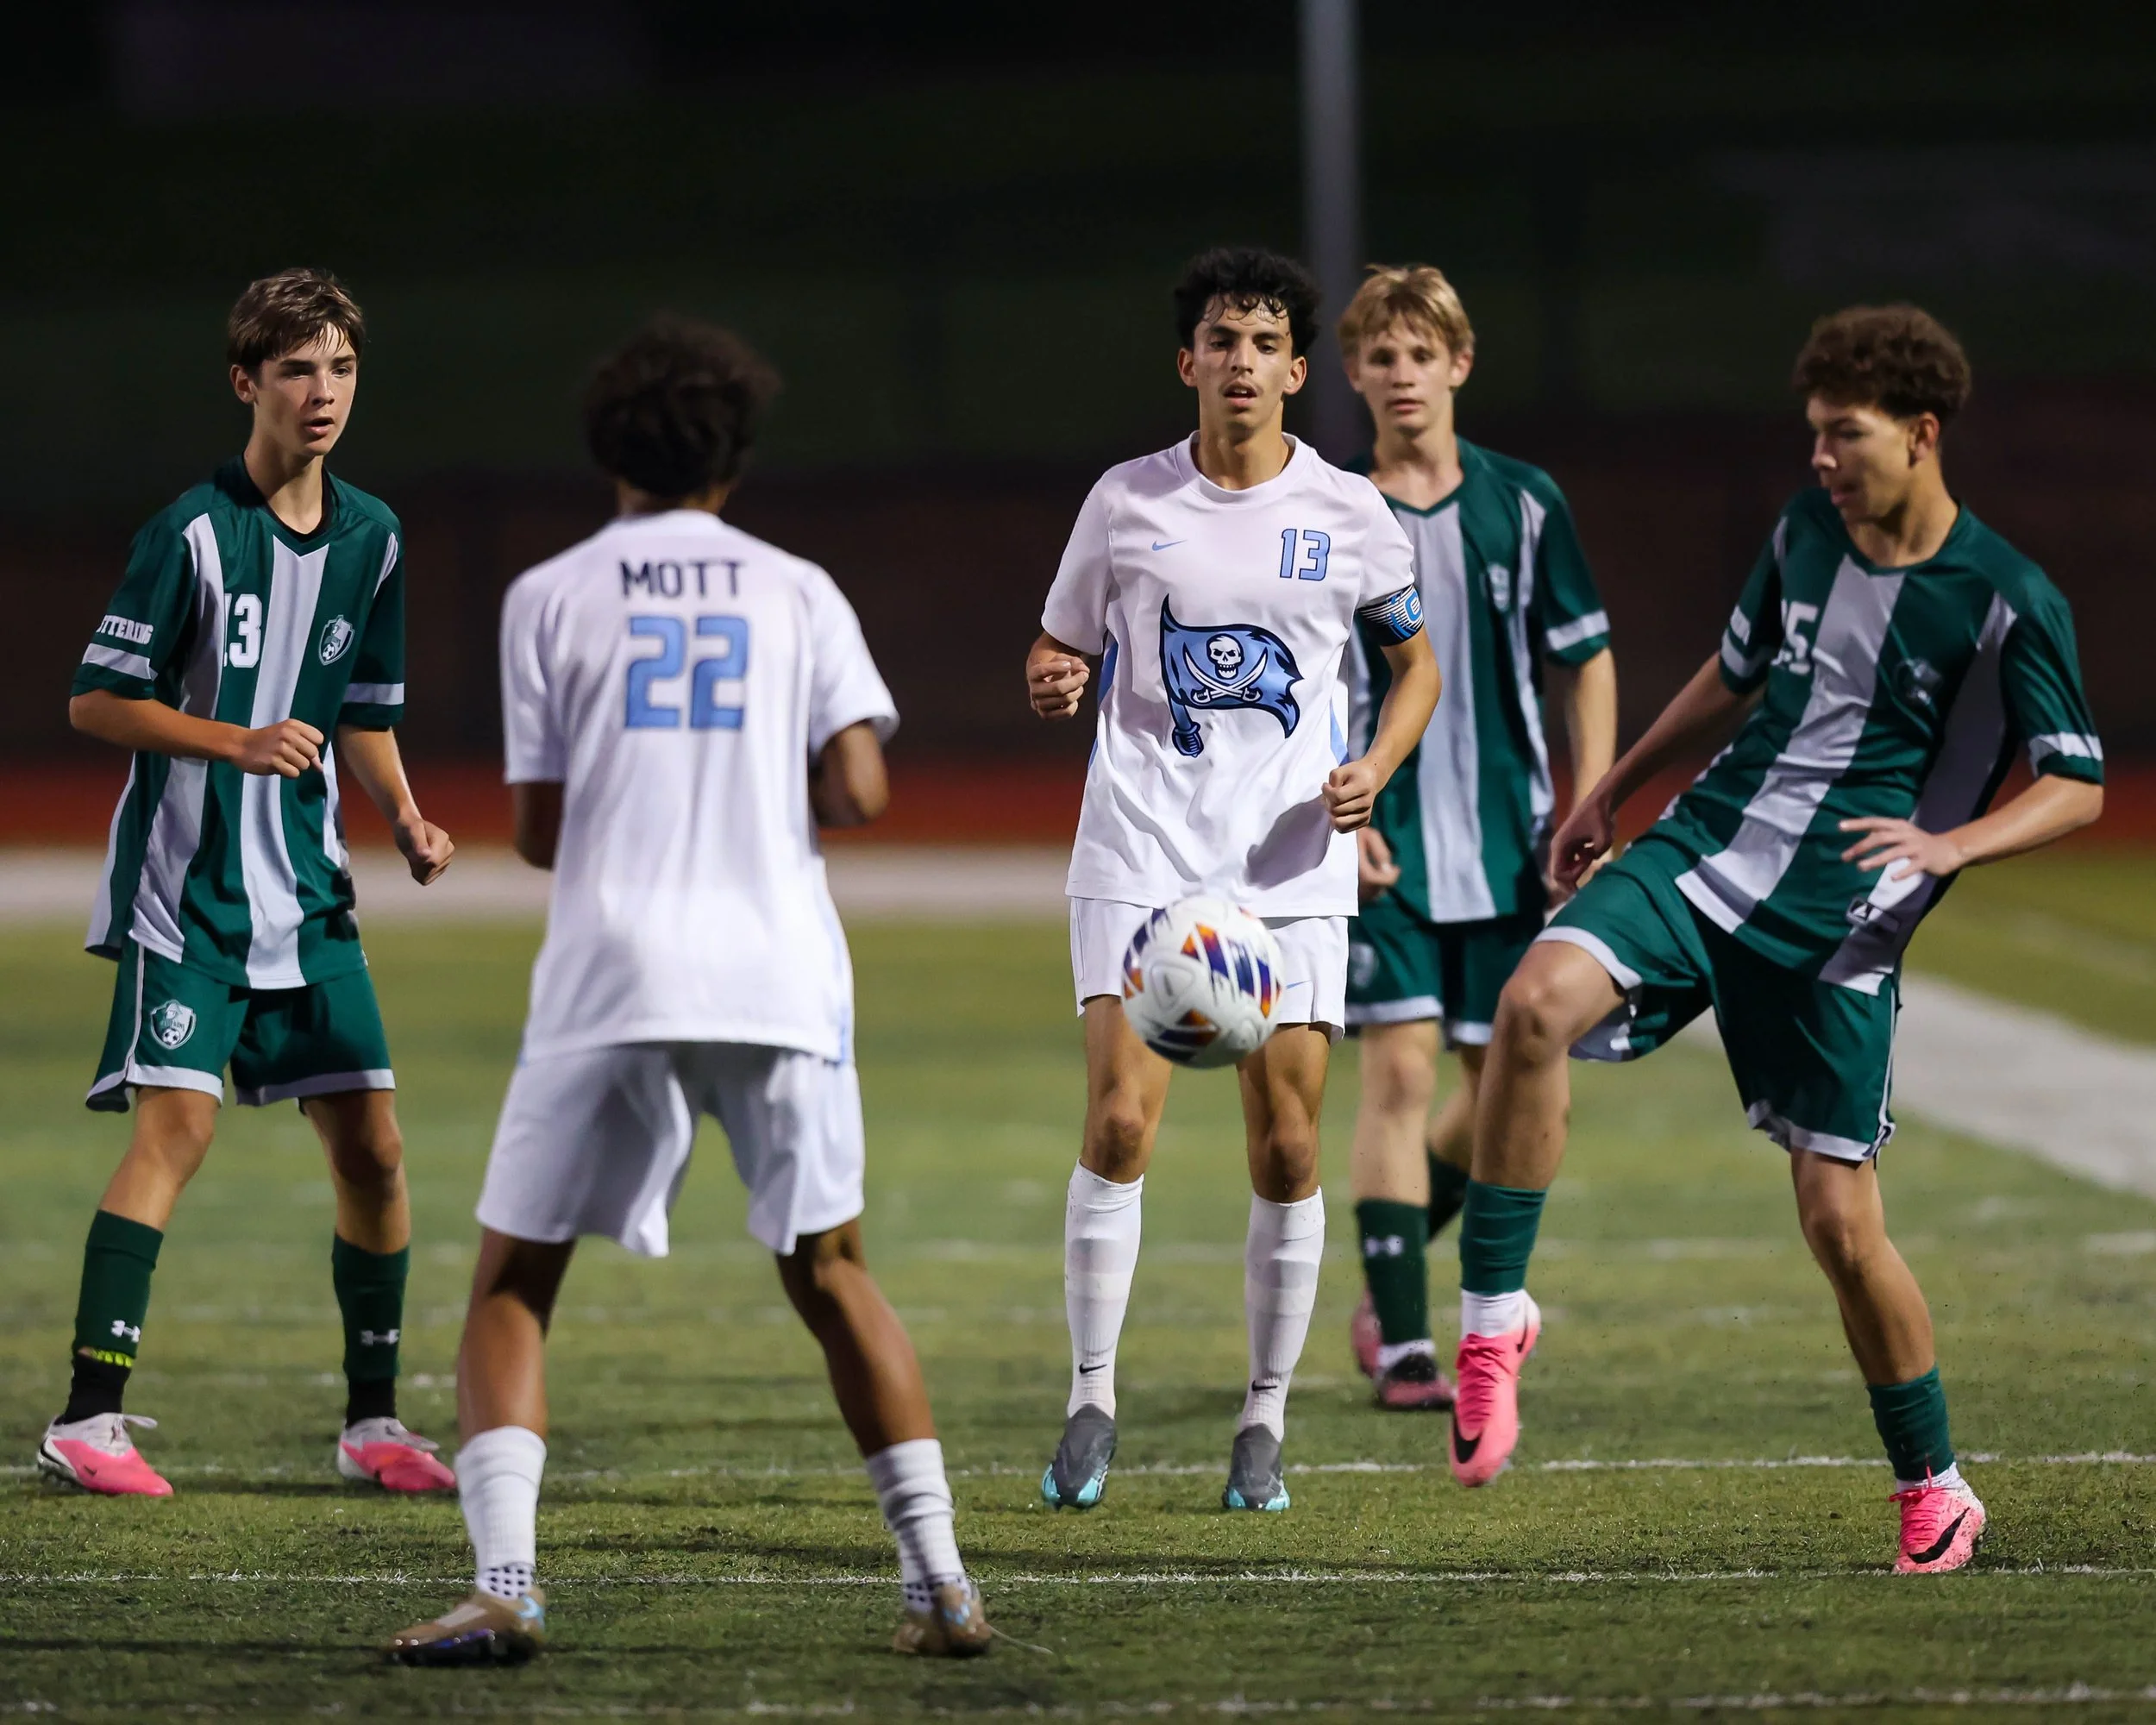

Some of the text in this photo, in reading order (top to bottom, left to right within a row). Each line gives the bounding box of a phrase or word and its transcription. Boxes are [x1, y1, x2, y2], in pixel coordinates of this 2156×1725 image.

[619, 559, 745, 596] MOTT
[1280, 528, 1331, 582] 13
[624, 614, 749, 730] 22
